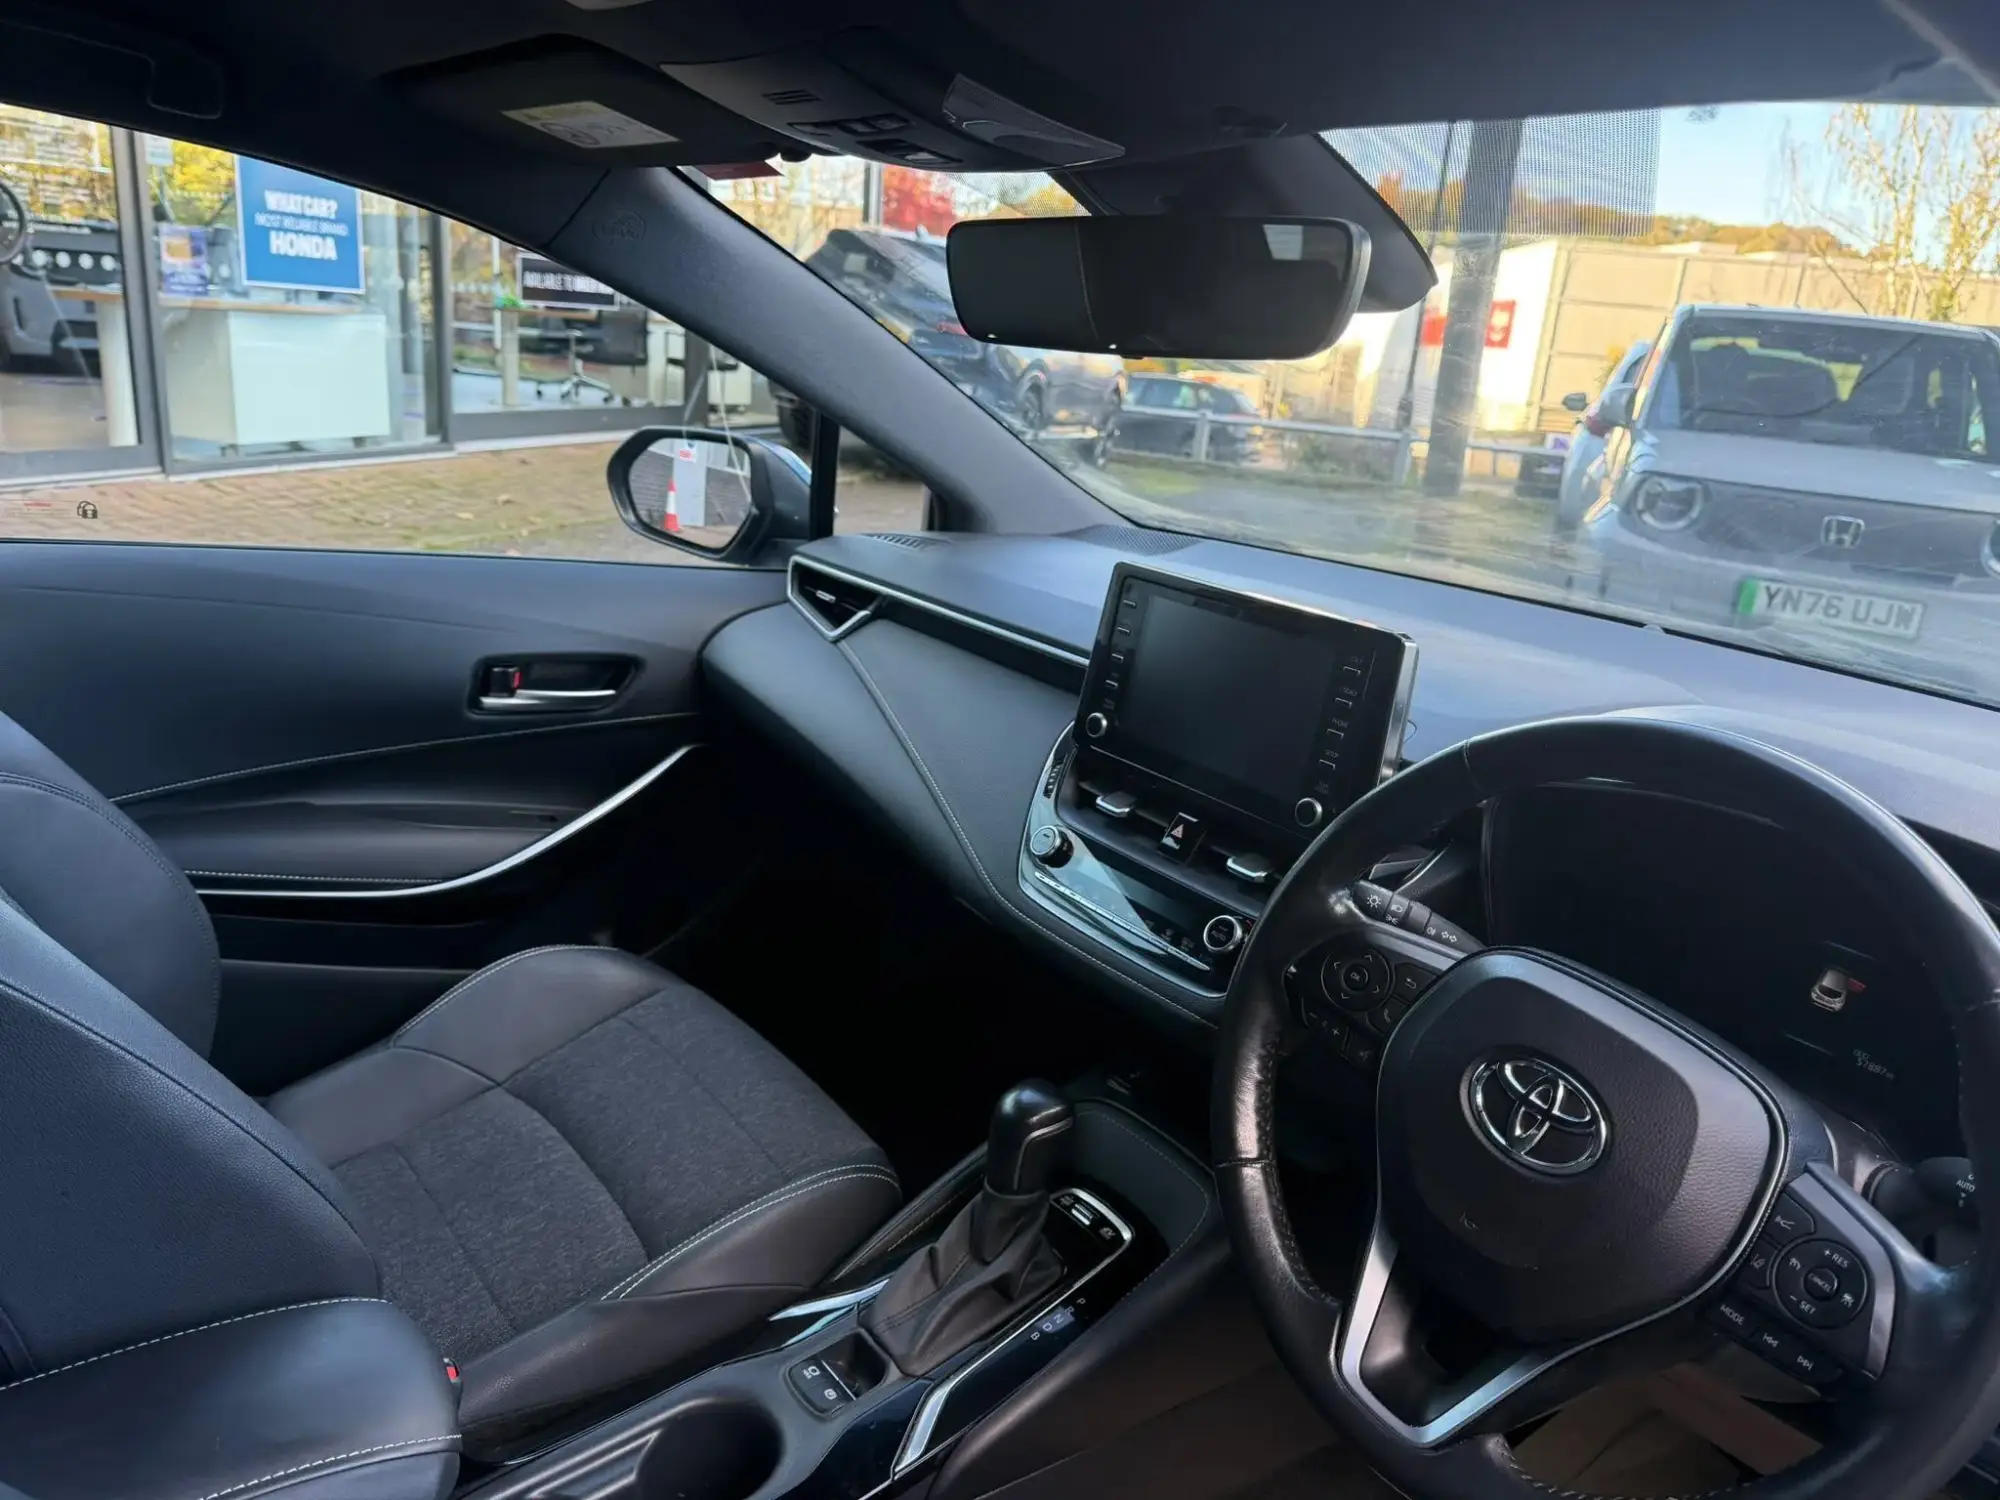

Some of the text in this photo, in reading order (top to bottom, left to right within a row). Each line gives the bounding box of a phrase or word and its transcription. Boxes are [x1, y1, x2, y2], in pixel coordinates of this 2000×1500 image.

[269, 230, 338, 260] HONDA
[1764, 584, 1844, 618] YN76
[1956, 1179, 1976, 1193] AUTO
[1832, 1253, 1849, 1269] RES
[1808, 1272, 1833, 1293] CANCEL
[1719, 1303, 1745, 1326] MODE
[1799, 1300, 1816, 1315] SET
